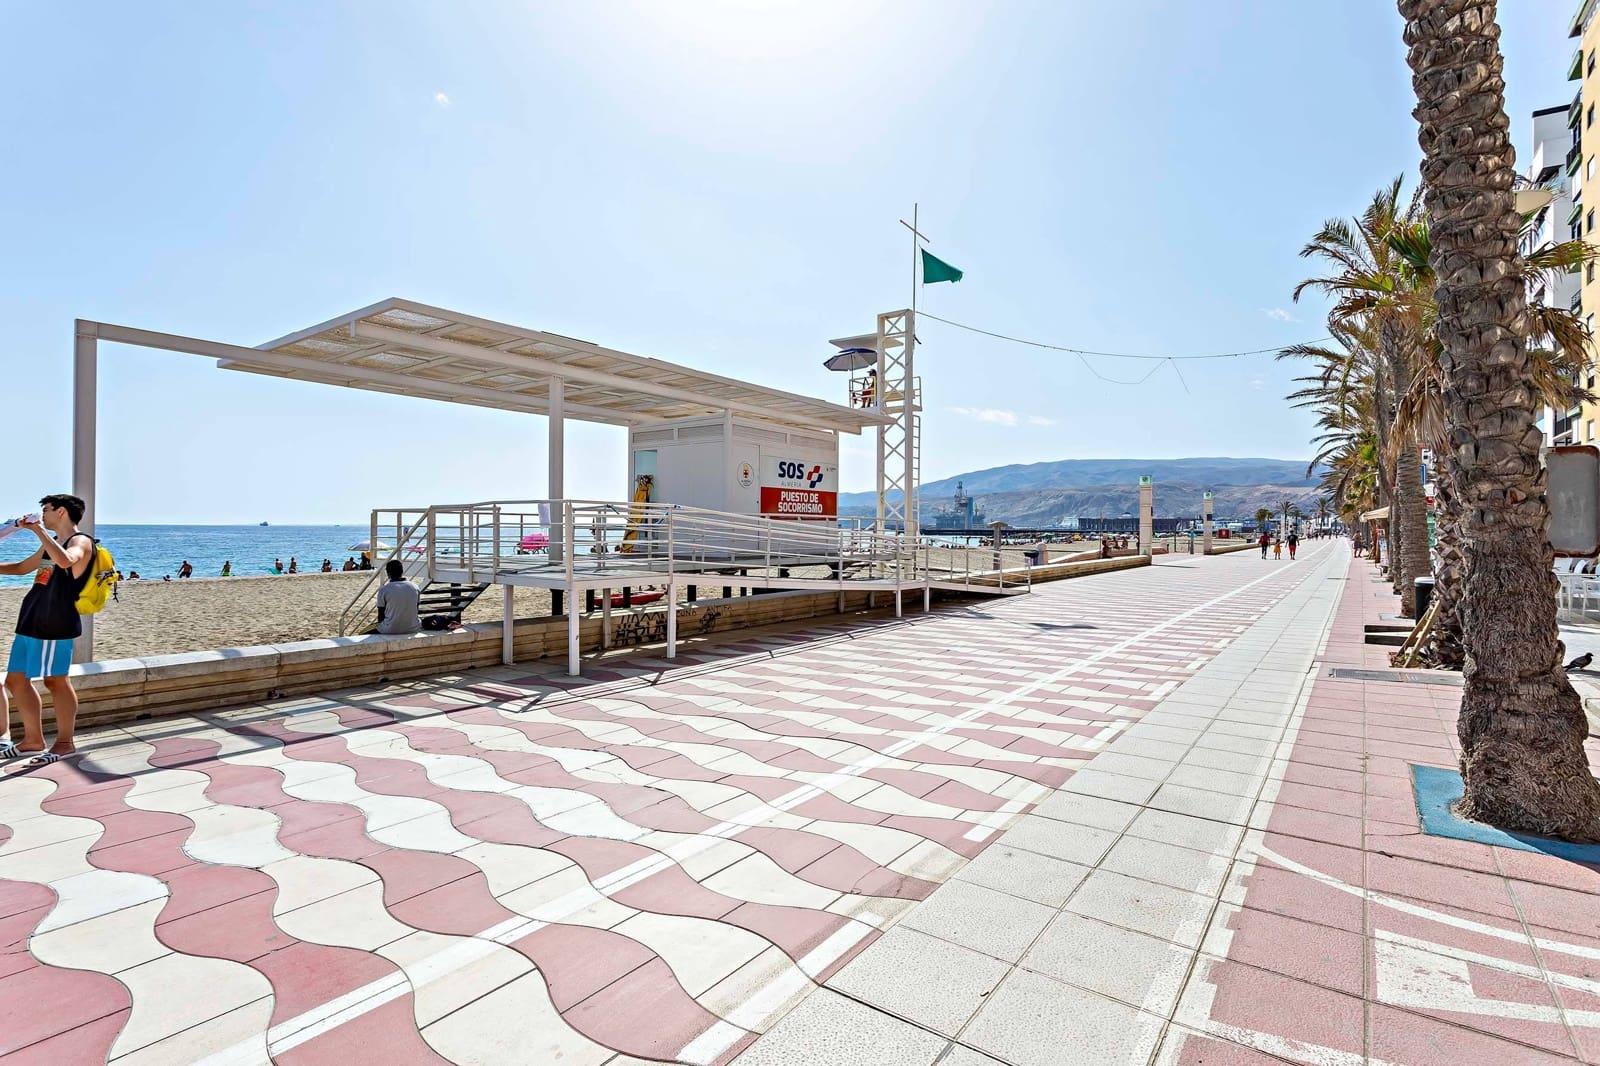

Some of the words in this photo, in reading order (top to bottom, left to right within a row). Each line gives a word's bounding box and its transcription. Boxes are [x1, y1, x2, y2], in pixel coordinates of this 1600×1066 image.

[778, 461, 805, 479] SOS
[781, 491, 808, 502] PUESTO
[809, 493, 819, 503] DE
[778, 502, 823, 513] SOCORRISMO
